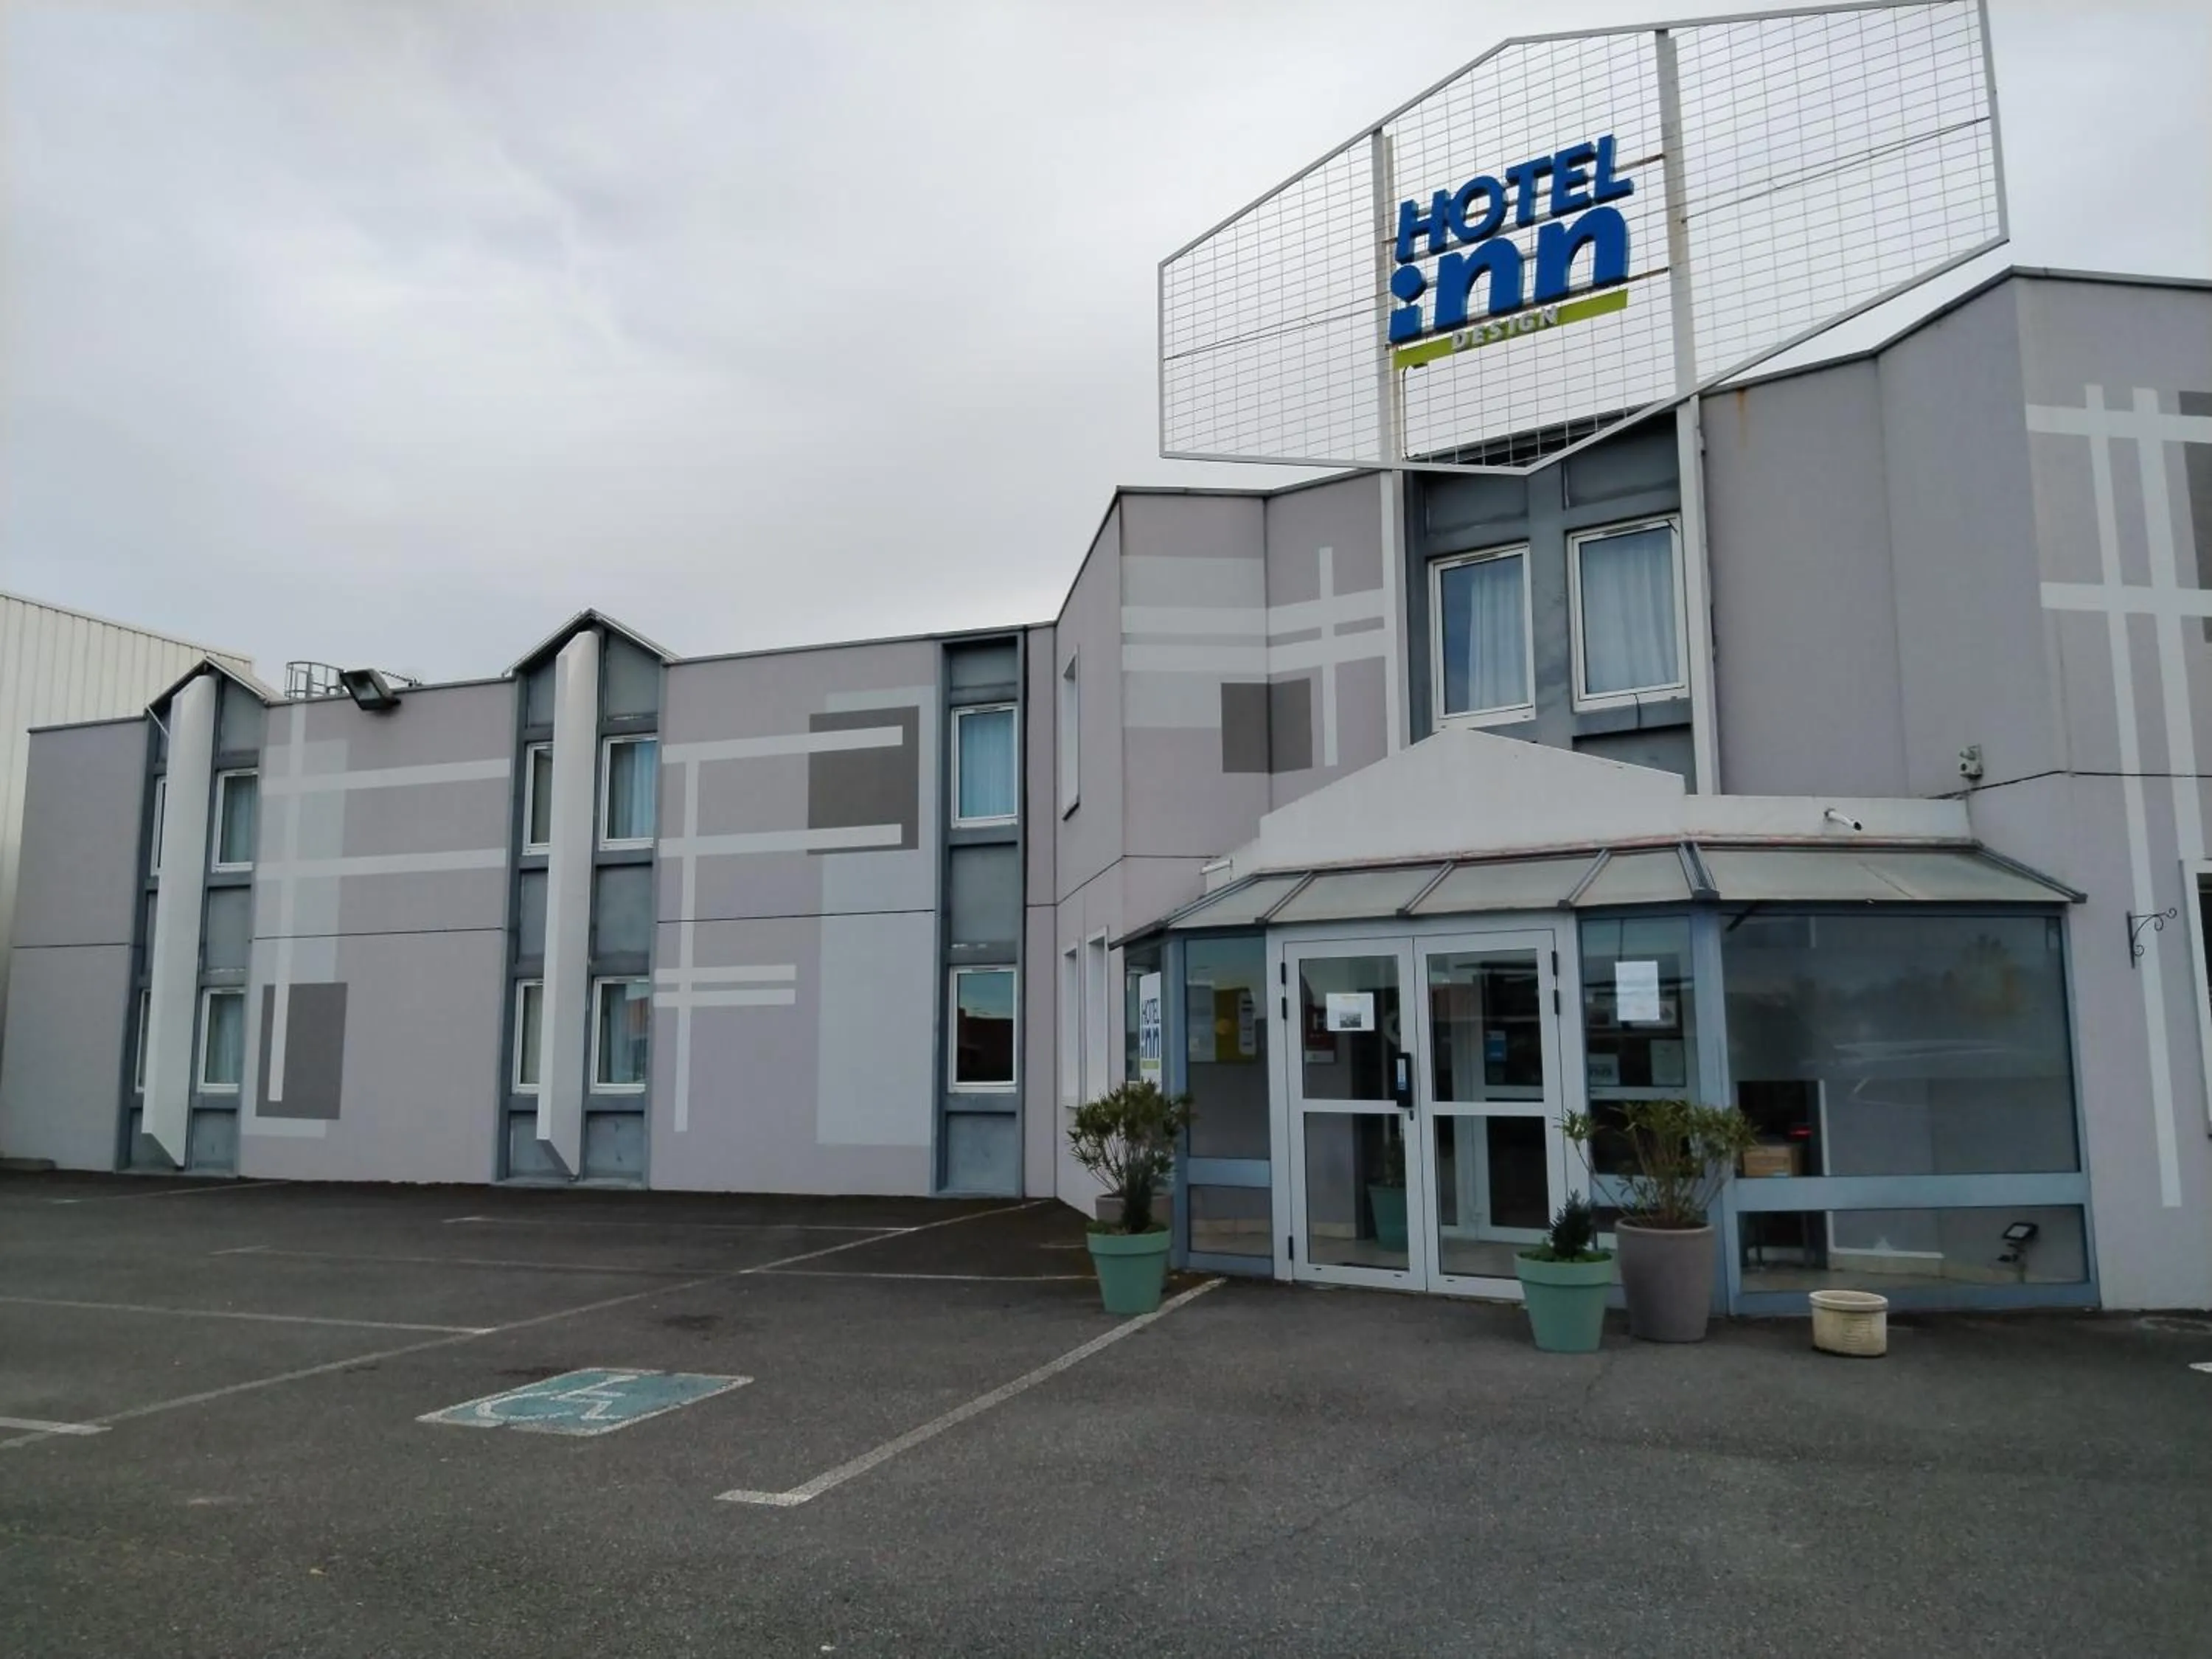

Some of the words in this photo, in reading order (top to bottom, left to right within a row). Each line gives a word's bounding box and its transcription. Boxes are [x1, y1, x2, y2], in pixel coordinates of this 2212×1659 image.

[1394, 133, 1634, 264] HOTEL
[1389, 206, 1631, 344] inn
[1452, 305, 1559, 352] DESIGN
